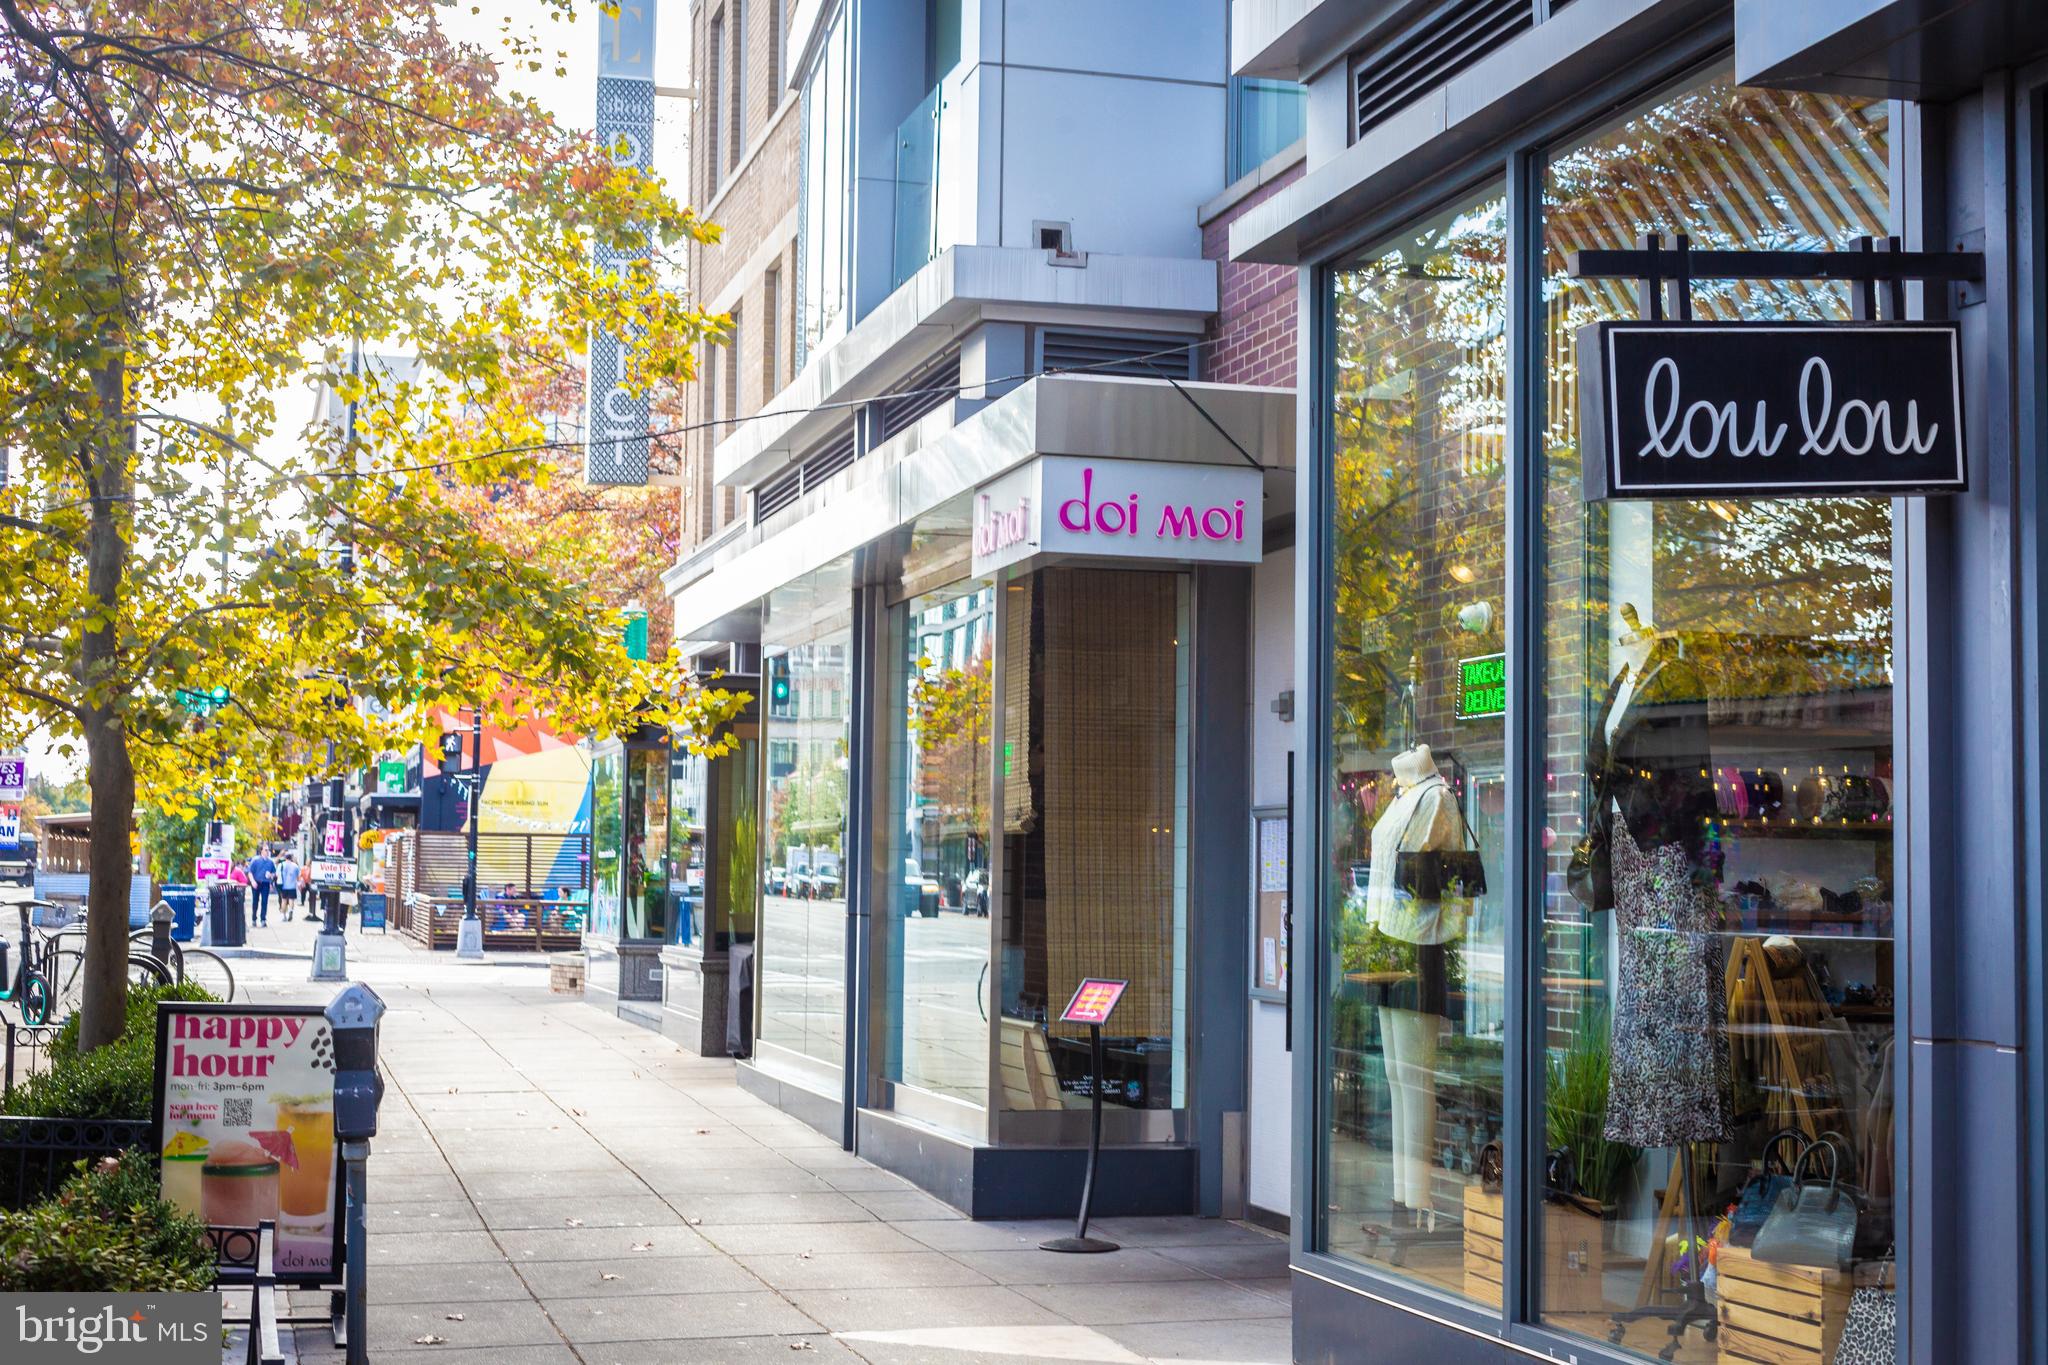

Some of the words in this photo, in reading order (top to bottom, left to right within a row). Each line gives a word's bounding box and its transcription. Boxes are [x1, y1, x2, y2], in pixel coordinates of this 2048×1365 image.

[1638, 356, 1788, 458] lou
[1799, 355, 1939, 456] lou
[1057, 467, 1140, 538] doi
[0, 762, 17, 774] ES
[5, 773, 21, 786] 83
[320, 864, 337, 872] Vote
[339, 864, 352, 872] YES
[173, 1014, 306, 1049] happy
[172, 1044, 275, 1077] hour
[169, 1103, 193, 1111] scan
[196, 1102, 218, 1111] here
[169, 1111, 184, 1120] for
[187, 1112, 215, 1120] menu
[282, 1249, 304, 1267] doi
